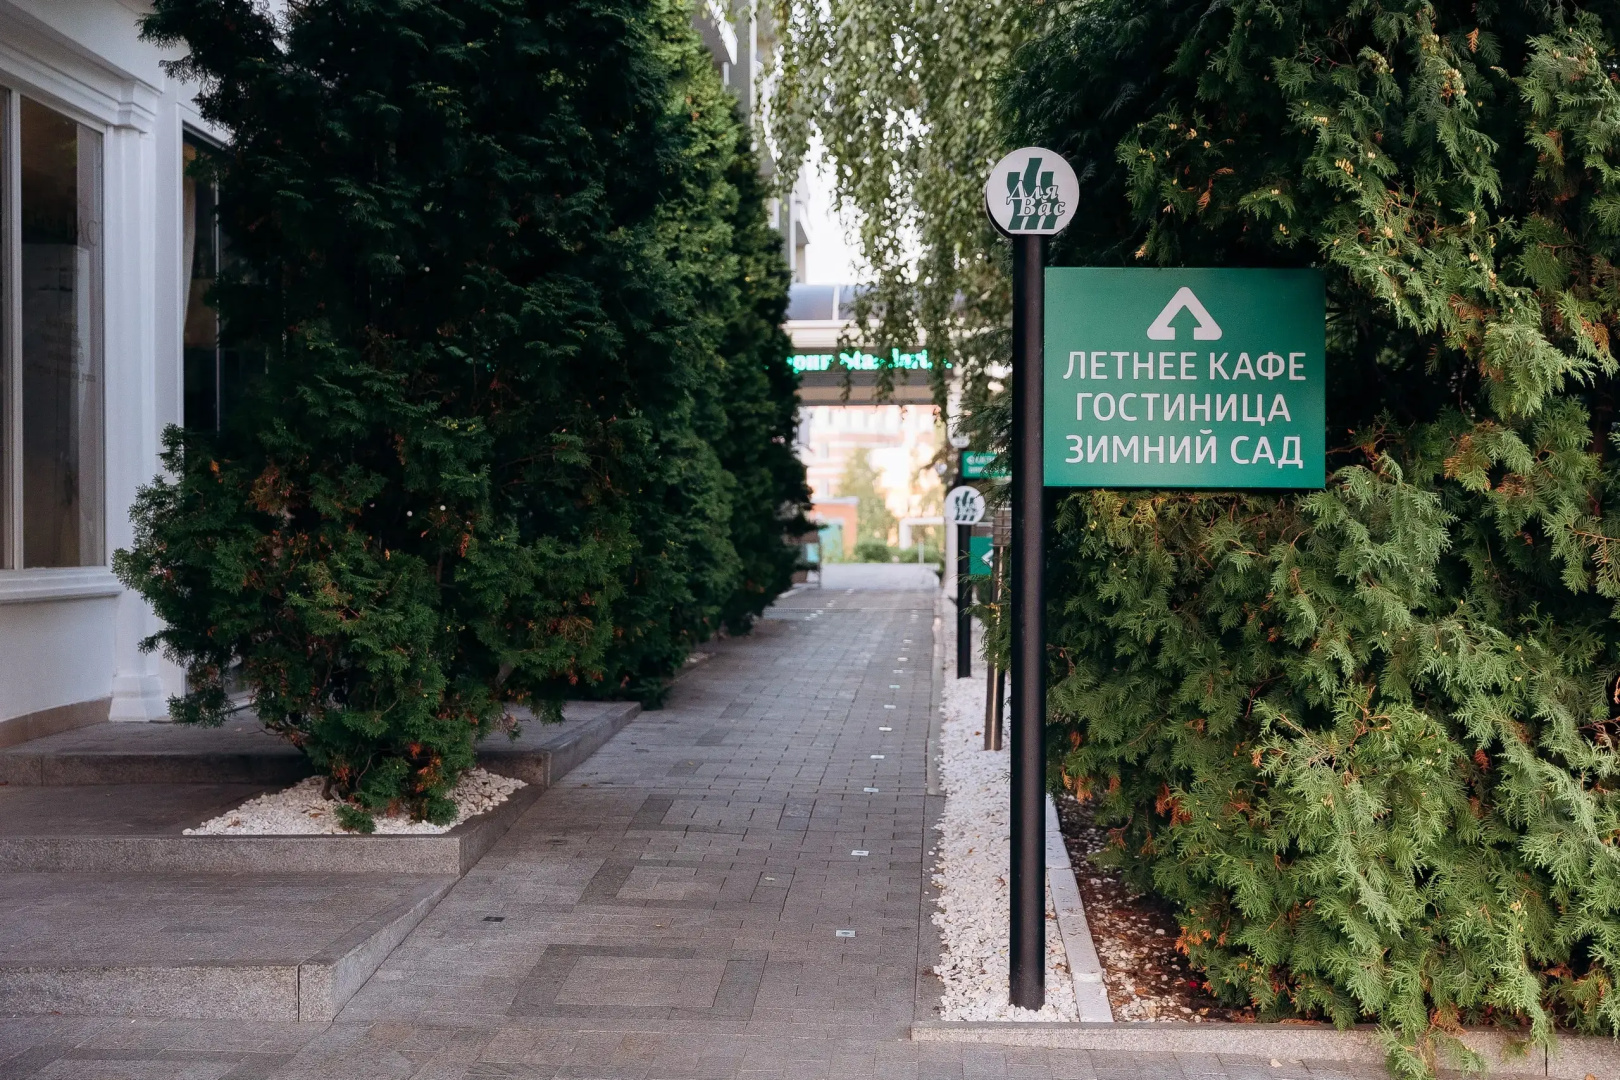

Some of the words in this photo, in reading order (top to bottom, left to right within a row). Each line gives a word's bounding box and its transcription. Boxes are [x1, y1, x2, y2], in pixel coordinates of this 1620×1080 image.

[1006, 180, 1059, 205] Для
[1016, 197, 1066, 217] Вас
[1063, 351, 1197, 380] ЛЕТНЕЕ
[1209, 351, 1306, 381] КАФЕ
[1076, 392, 1291, 426] ГОСТИНИЦА
[1065, 429, 1217, 464] ЗИМНИЙ
[1230, 435, 1304, 469] САД
